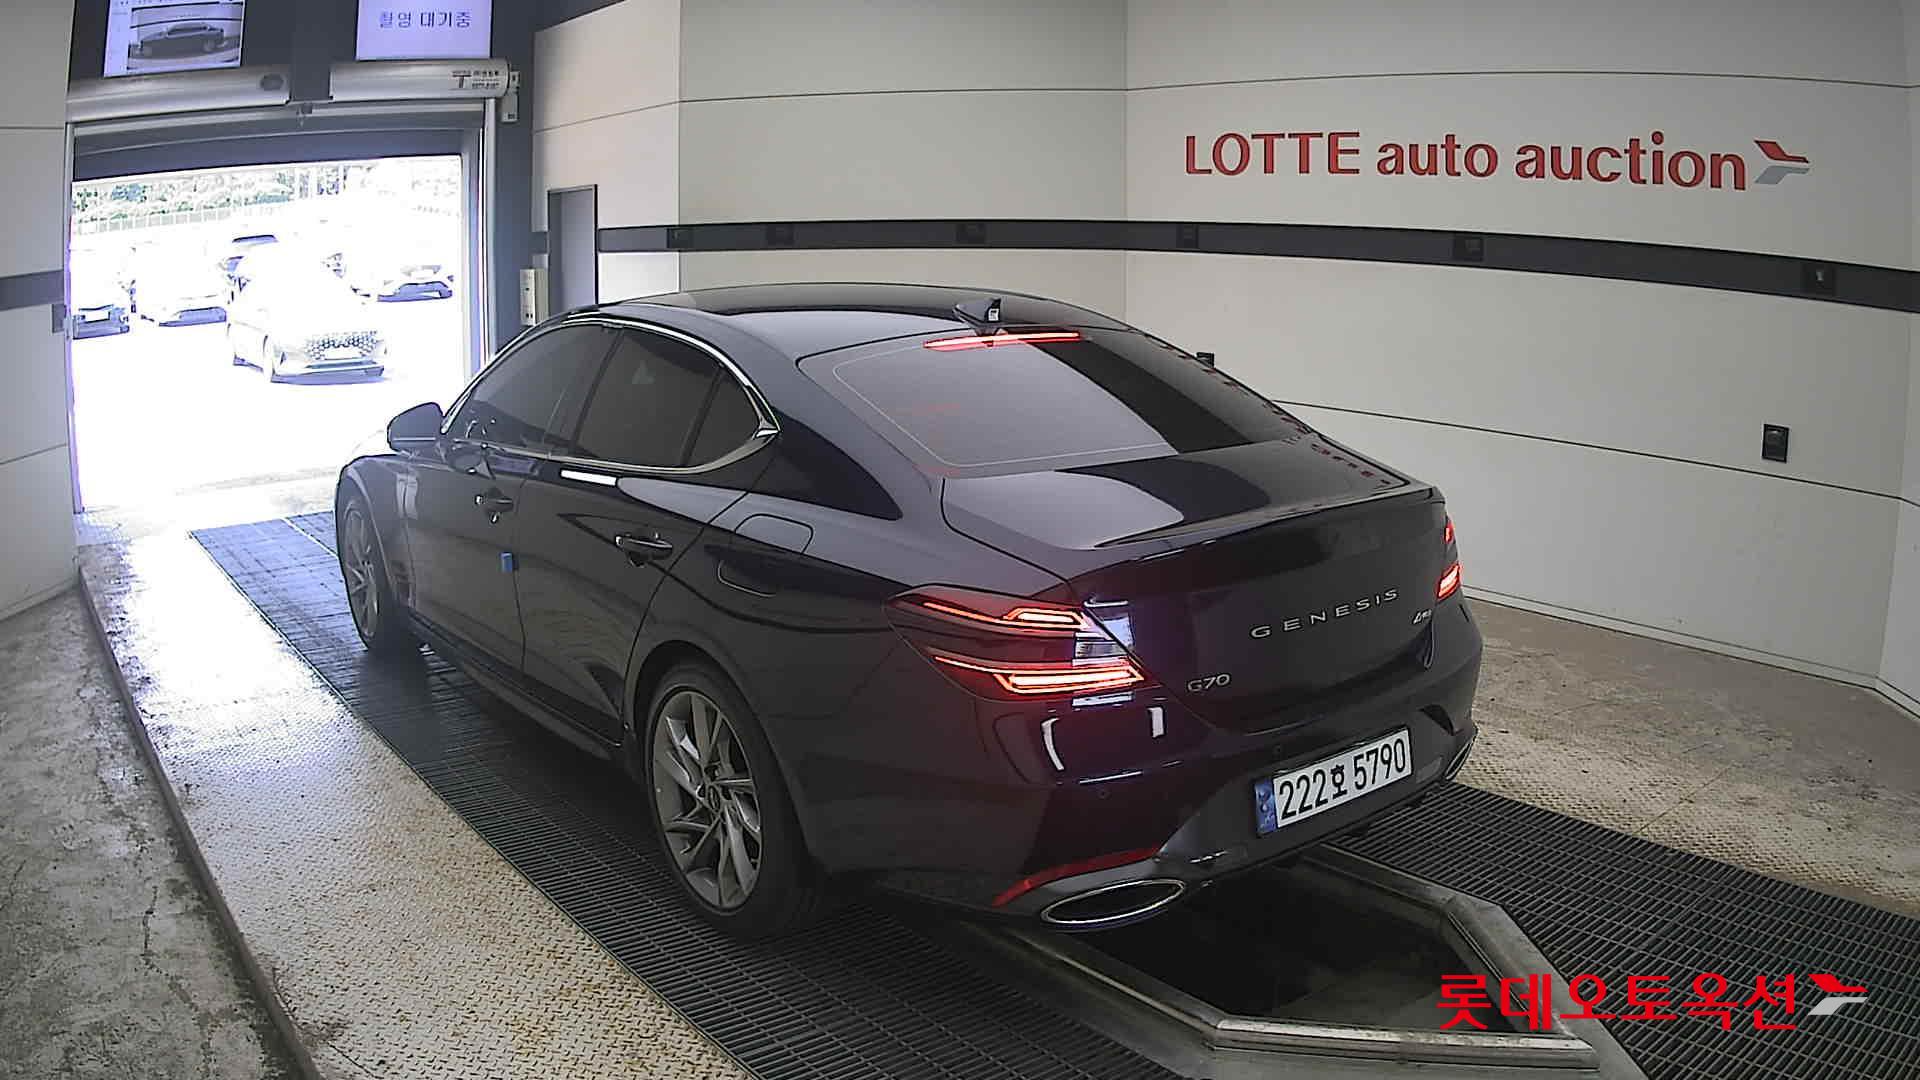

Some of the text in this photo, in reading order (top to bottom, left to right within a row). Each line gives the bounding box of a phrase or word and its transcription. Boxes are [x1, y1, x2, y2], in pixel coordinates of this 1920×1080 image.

[420, 11, 472, 28] 대기중
[1185, 131, 1747, 191] LOTTE auto auction
[1250, 588, 1400, 638] GENESIS
[1186, 672, 1232, 693] G70
